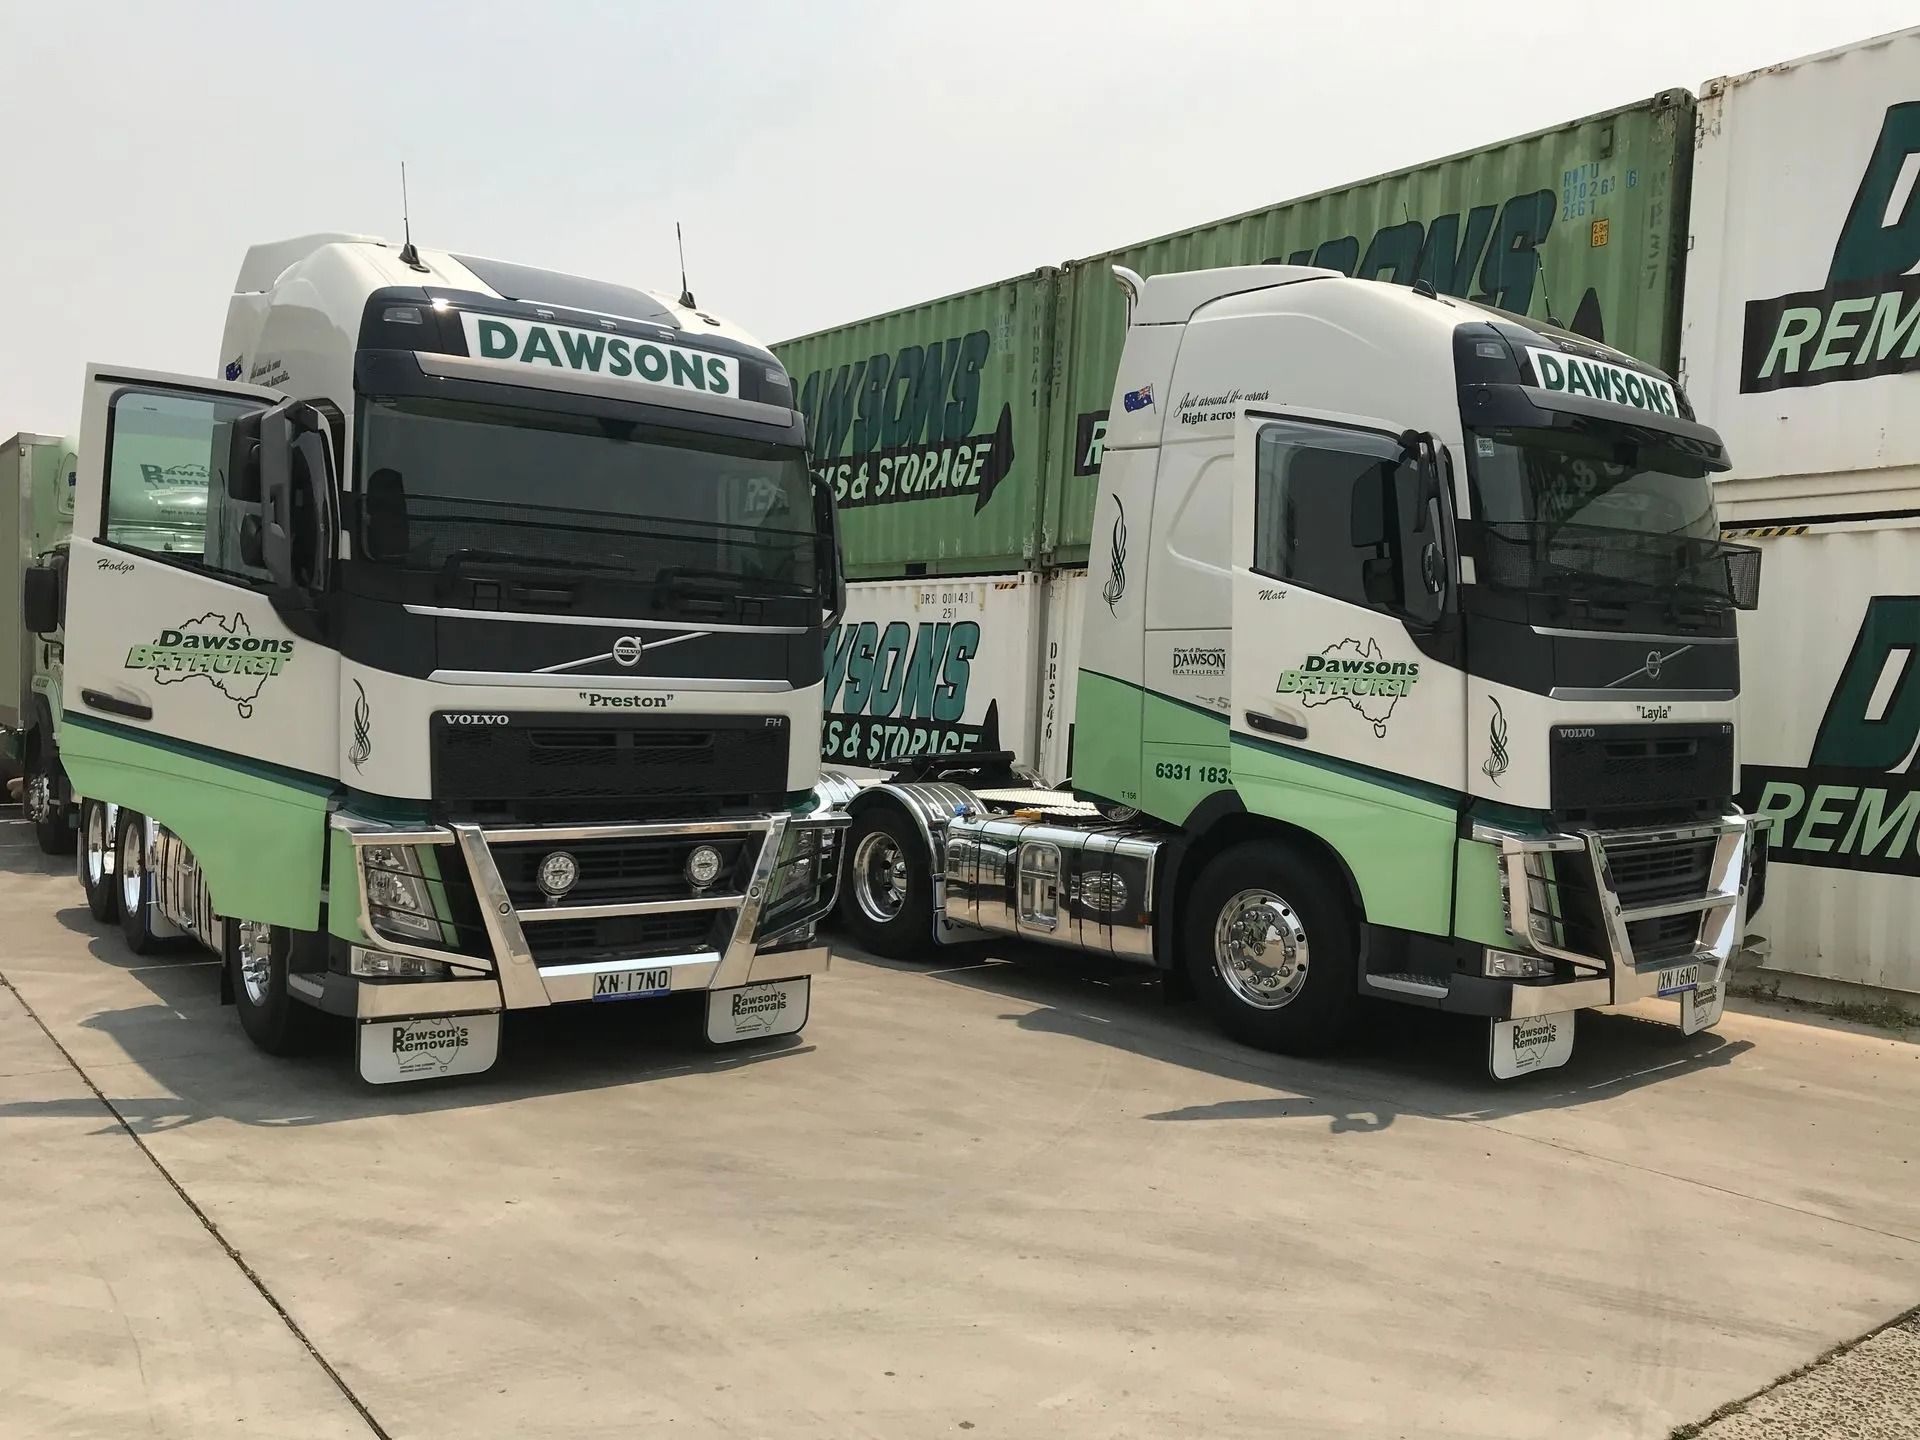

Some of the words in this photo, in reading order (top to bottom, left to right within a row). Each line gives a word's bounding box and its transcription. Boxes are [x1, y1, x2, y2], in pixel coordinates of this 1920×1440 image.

[478, 319, 730, 395] DAWSONS
[1537, 353, 1676, 418] DAWSONS
[1199, 389, 1230, 407] around
[1181, 411, 1208, 425] Right
[875, 443, 991, 497] STORAGE
[97, 558, 135, 575] Hodgo
[1258, 589, 1288, 601] Matt
[159, 630, 294, 653] Dawsons
[124, 645, 291, 676] BATHURST
[1173, 653, 1226, 669] DAWSON
[1305, 655, 1420, 676] Dawsons
[1276, 670, 1418, 698] BATHURST
[442, 714, 509, 726] VOLVO
[764, 718, 782, 728] FH
[1558, 728, 1595, 738] VOLVO
[1155, 762, 1191, 781] 6331
[732, 991, 787, 1006] Dawson's
[732, 1000, 787, 1016] Removals
[393, 1026, 468, 1042] Dawson's
[1513, 1024, 1557, 1039] Dawson's
[392, 1036, 468, 1053] Removals
[1513, 1033, 1556, 1049] Removals
